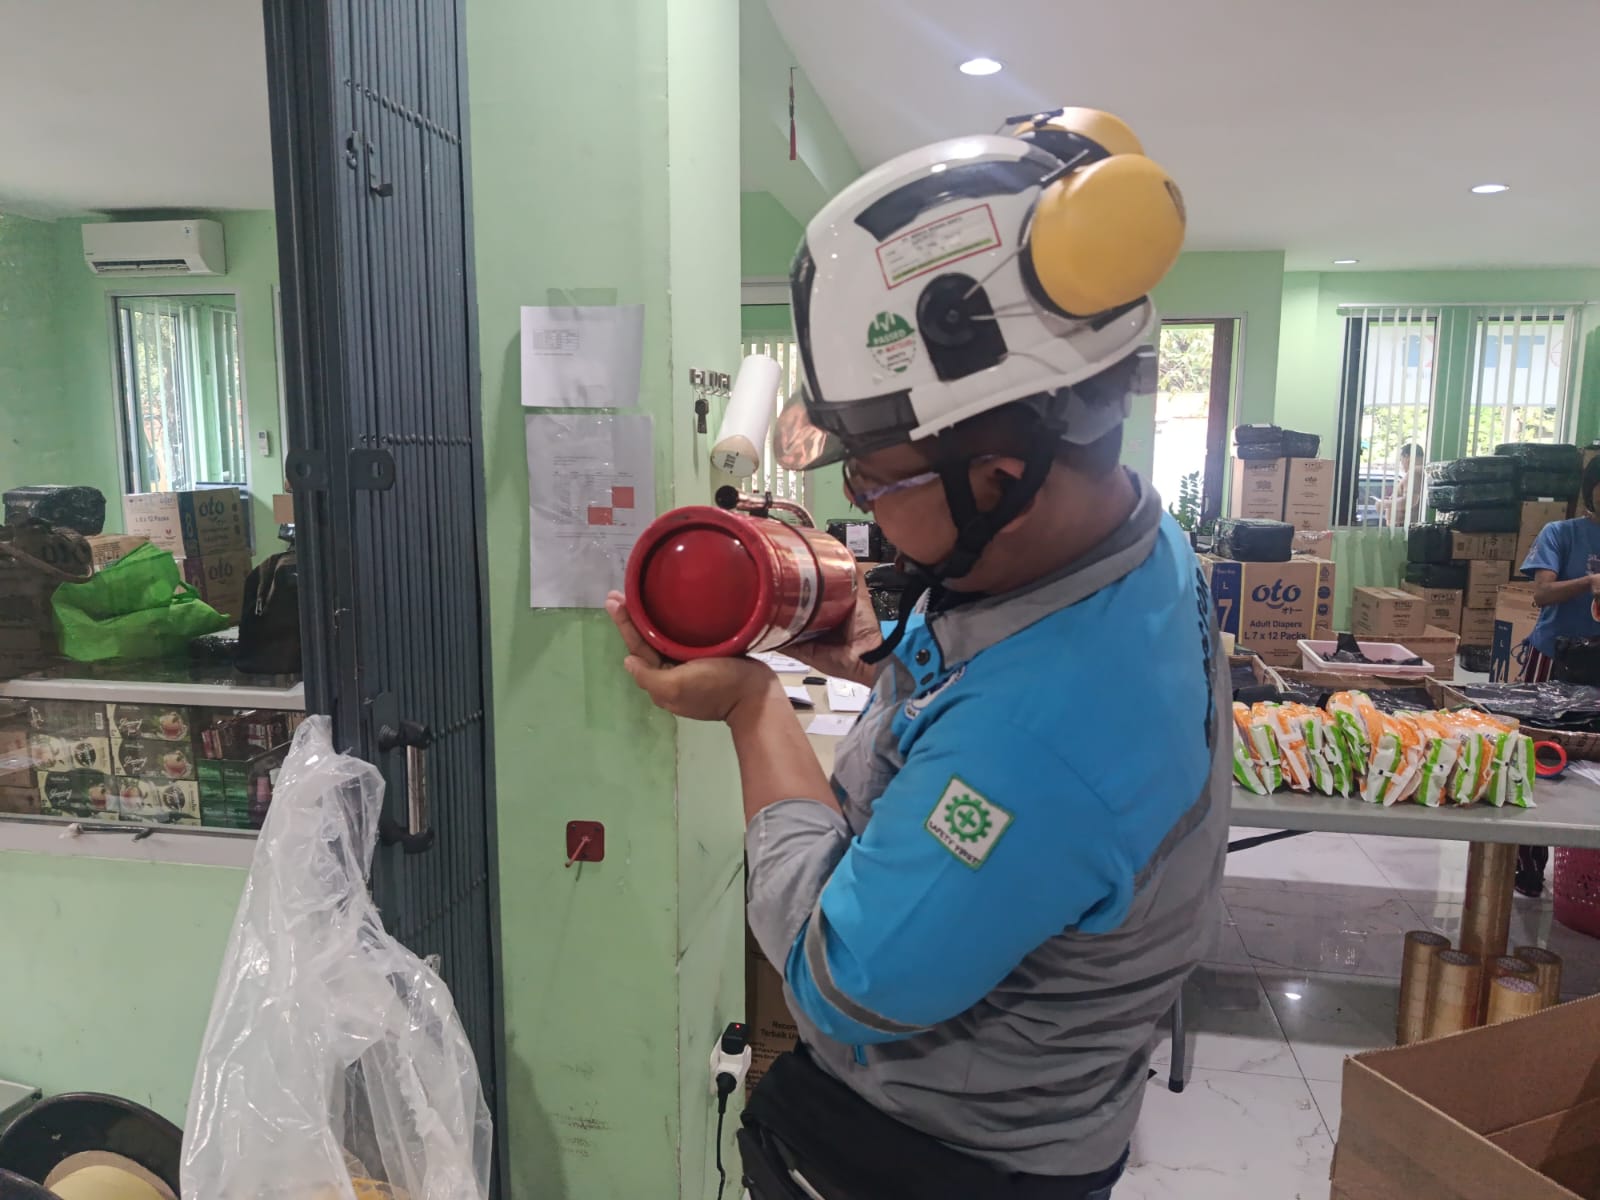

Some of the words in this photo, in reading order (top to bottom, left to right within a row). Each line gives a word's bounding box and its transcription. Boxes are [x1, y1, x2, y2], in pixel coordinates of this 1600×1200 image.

[199, 496, 224, 517] oto
[208, 559, 233, 580] oto
[1222, 581, 1229, 590] L
[1252, 577, 1302, 603] oto
[1217, 598, 1233, 631] 7
[1249, 620, 1271, 628] Adult
[1272, 620, 1302, 630] Diapers
[1244, 632, 1250, 640] L
[1252, 632, 1258, 640] 7
[1268, 631, 1279, 640] 12
[1280, 631, 1307, 641] Packs
[928, 820, 955, 845] SAFETY
[954, 844, 981, 864] FIRST
